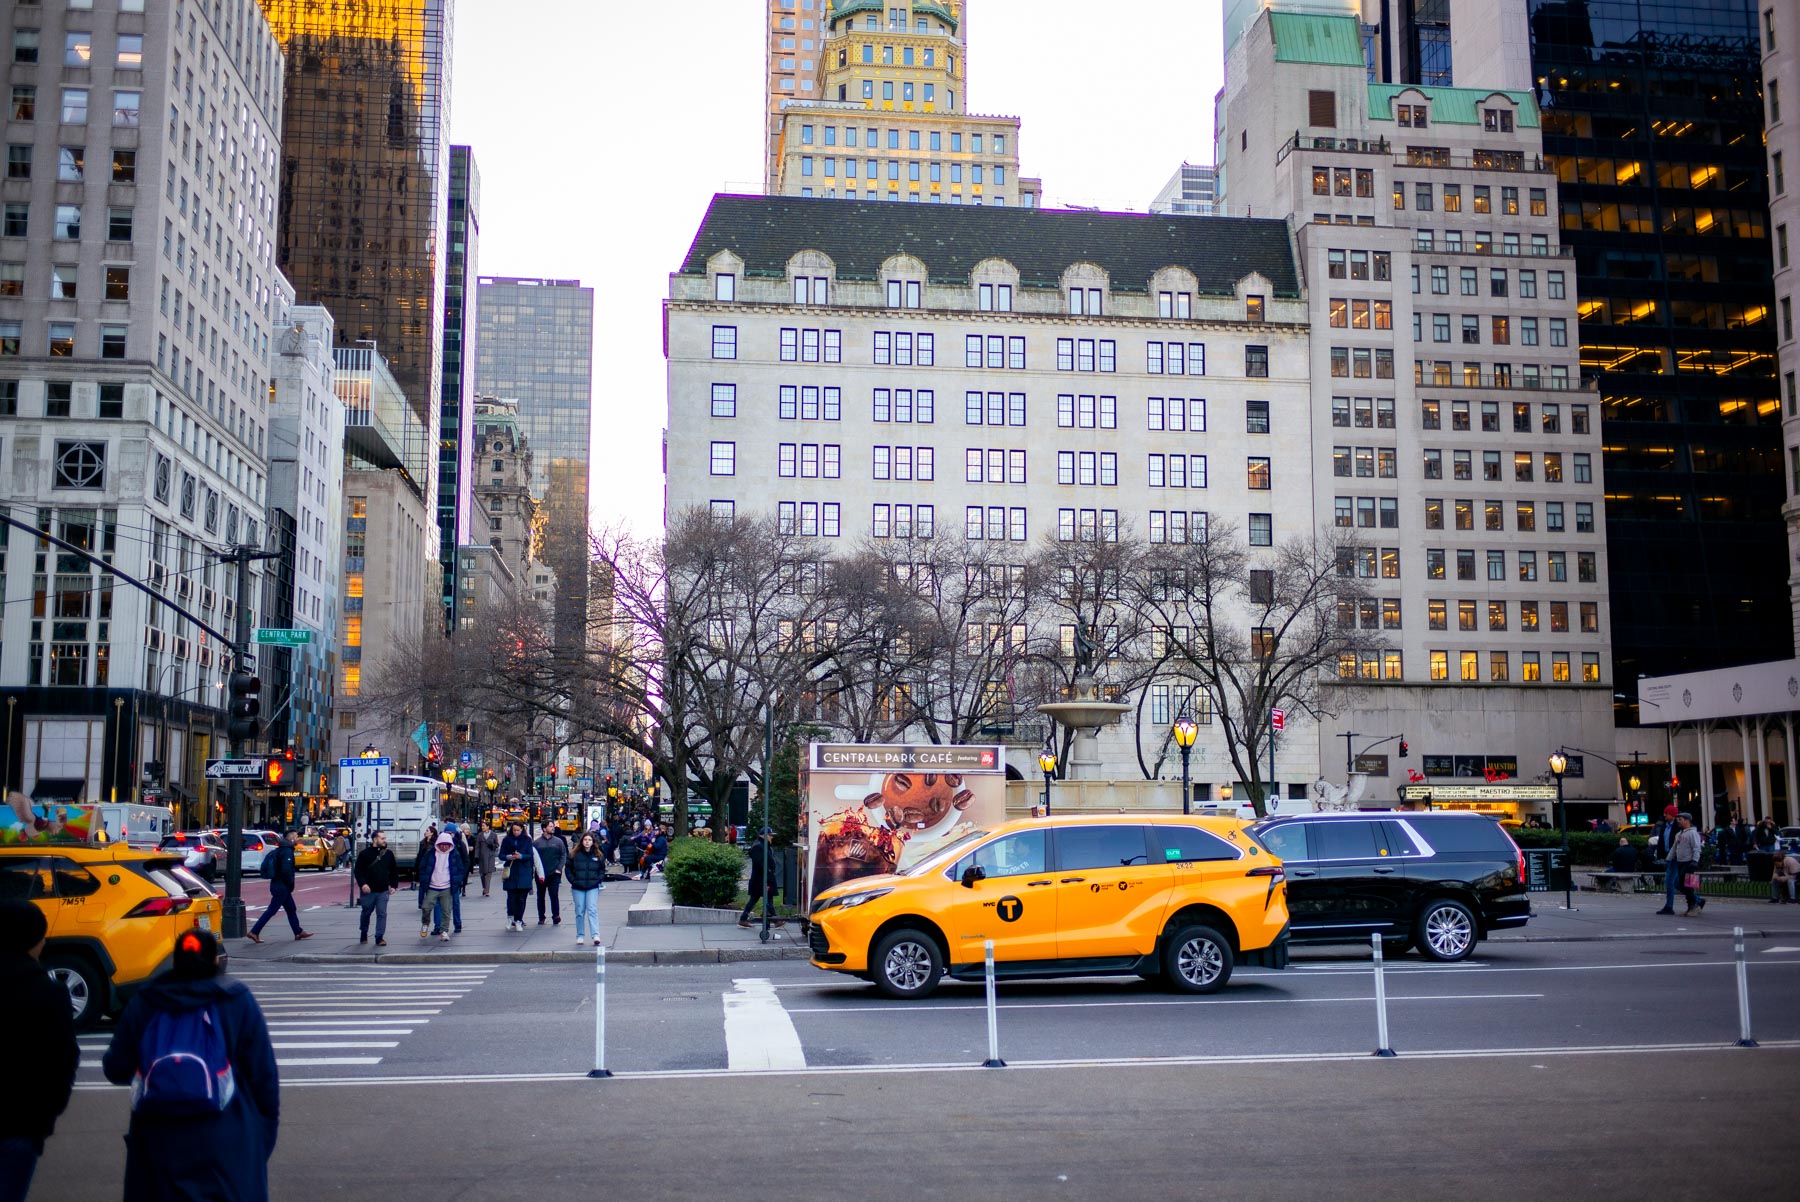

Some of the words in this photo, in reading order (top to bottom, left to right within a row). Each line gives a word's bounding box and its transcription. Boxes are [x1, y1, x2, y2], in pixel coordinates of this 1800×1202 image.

[260, 630, 288, 639] CENTRAL
[290, 631, 307, 639] PARK
[823, 753, 881, 763] CENTRAL
[885, 753, 917, 763] PARK
[920, 751, 953, 763] CAFÉ
[957, 754, 978, 762] featuring
[981, 753, 994, 764] illy
[213, 765, 230, 773] ONE
[237, 765, 255, 773] WAY
[1487, 762, 1516, 770] MAESTRO
[849, 843, 867, 858] illy
[1175, 862, 1195, 870] 2K22
[1001, 899, 1018, 920] T
